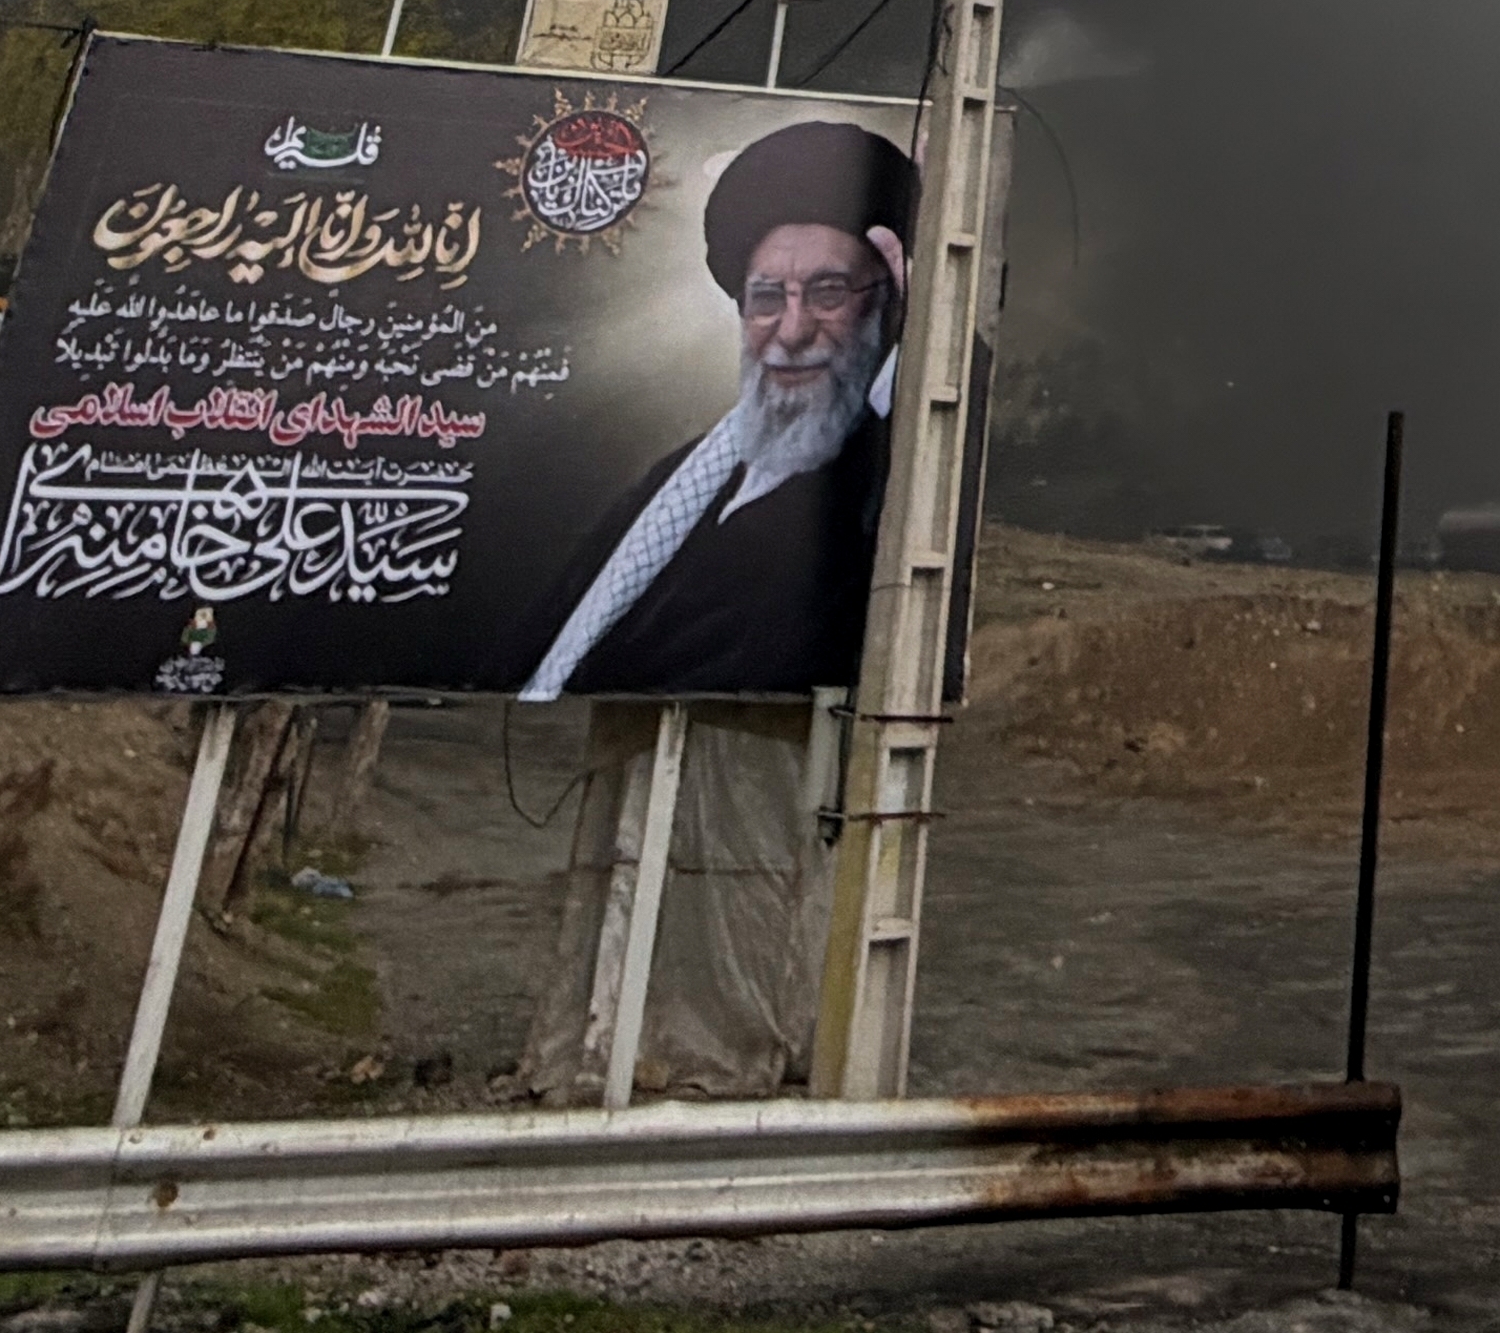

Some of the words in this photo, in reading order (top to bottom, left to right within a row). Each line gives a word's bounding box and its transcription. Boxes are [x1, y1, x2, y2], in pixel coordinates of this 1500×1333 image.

[29, 382, 171, 438] اسلامی
[164, 386, 278, 440] انقلاب
[418, 399, 486, 449] سید
[189, 451, 341, 601] علی
